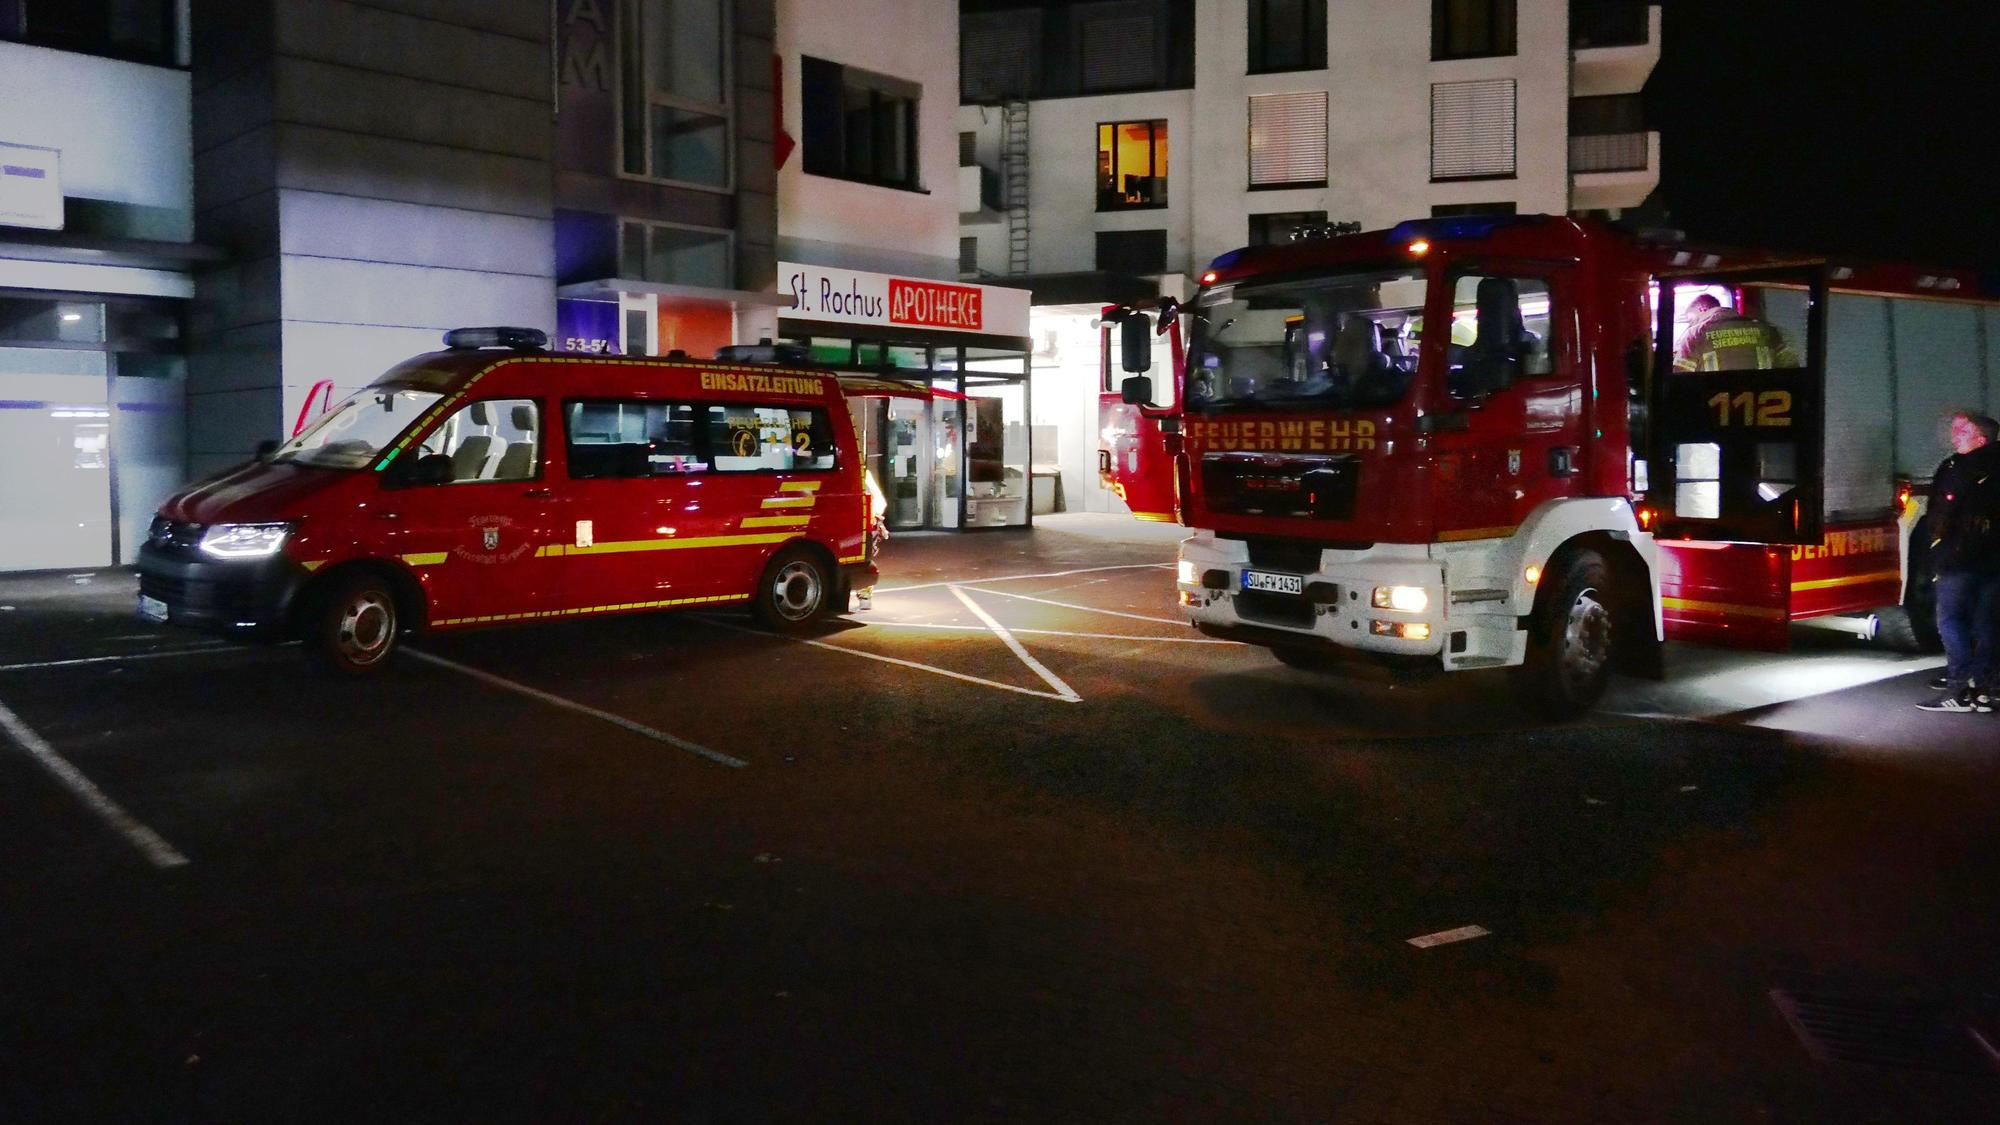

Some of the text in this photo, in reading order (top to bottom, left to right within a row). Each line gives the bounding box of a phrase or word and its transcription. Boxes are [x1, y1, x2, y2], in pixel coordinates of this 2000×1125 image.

[791, 272, 978, 326] St. Rochus APOTHEKE
[700, 372, 824, 395] EINSATZLEITUNG
[1707, 389, 1792, 427] 112
[1193, 419, 1376, 451] FEUERWEHR
[1248, 573, 1300, 592] SU FW 1431
